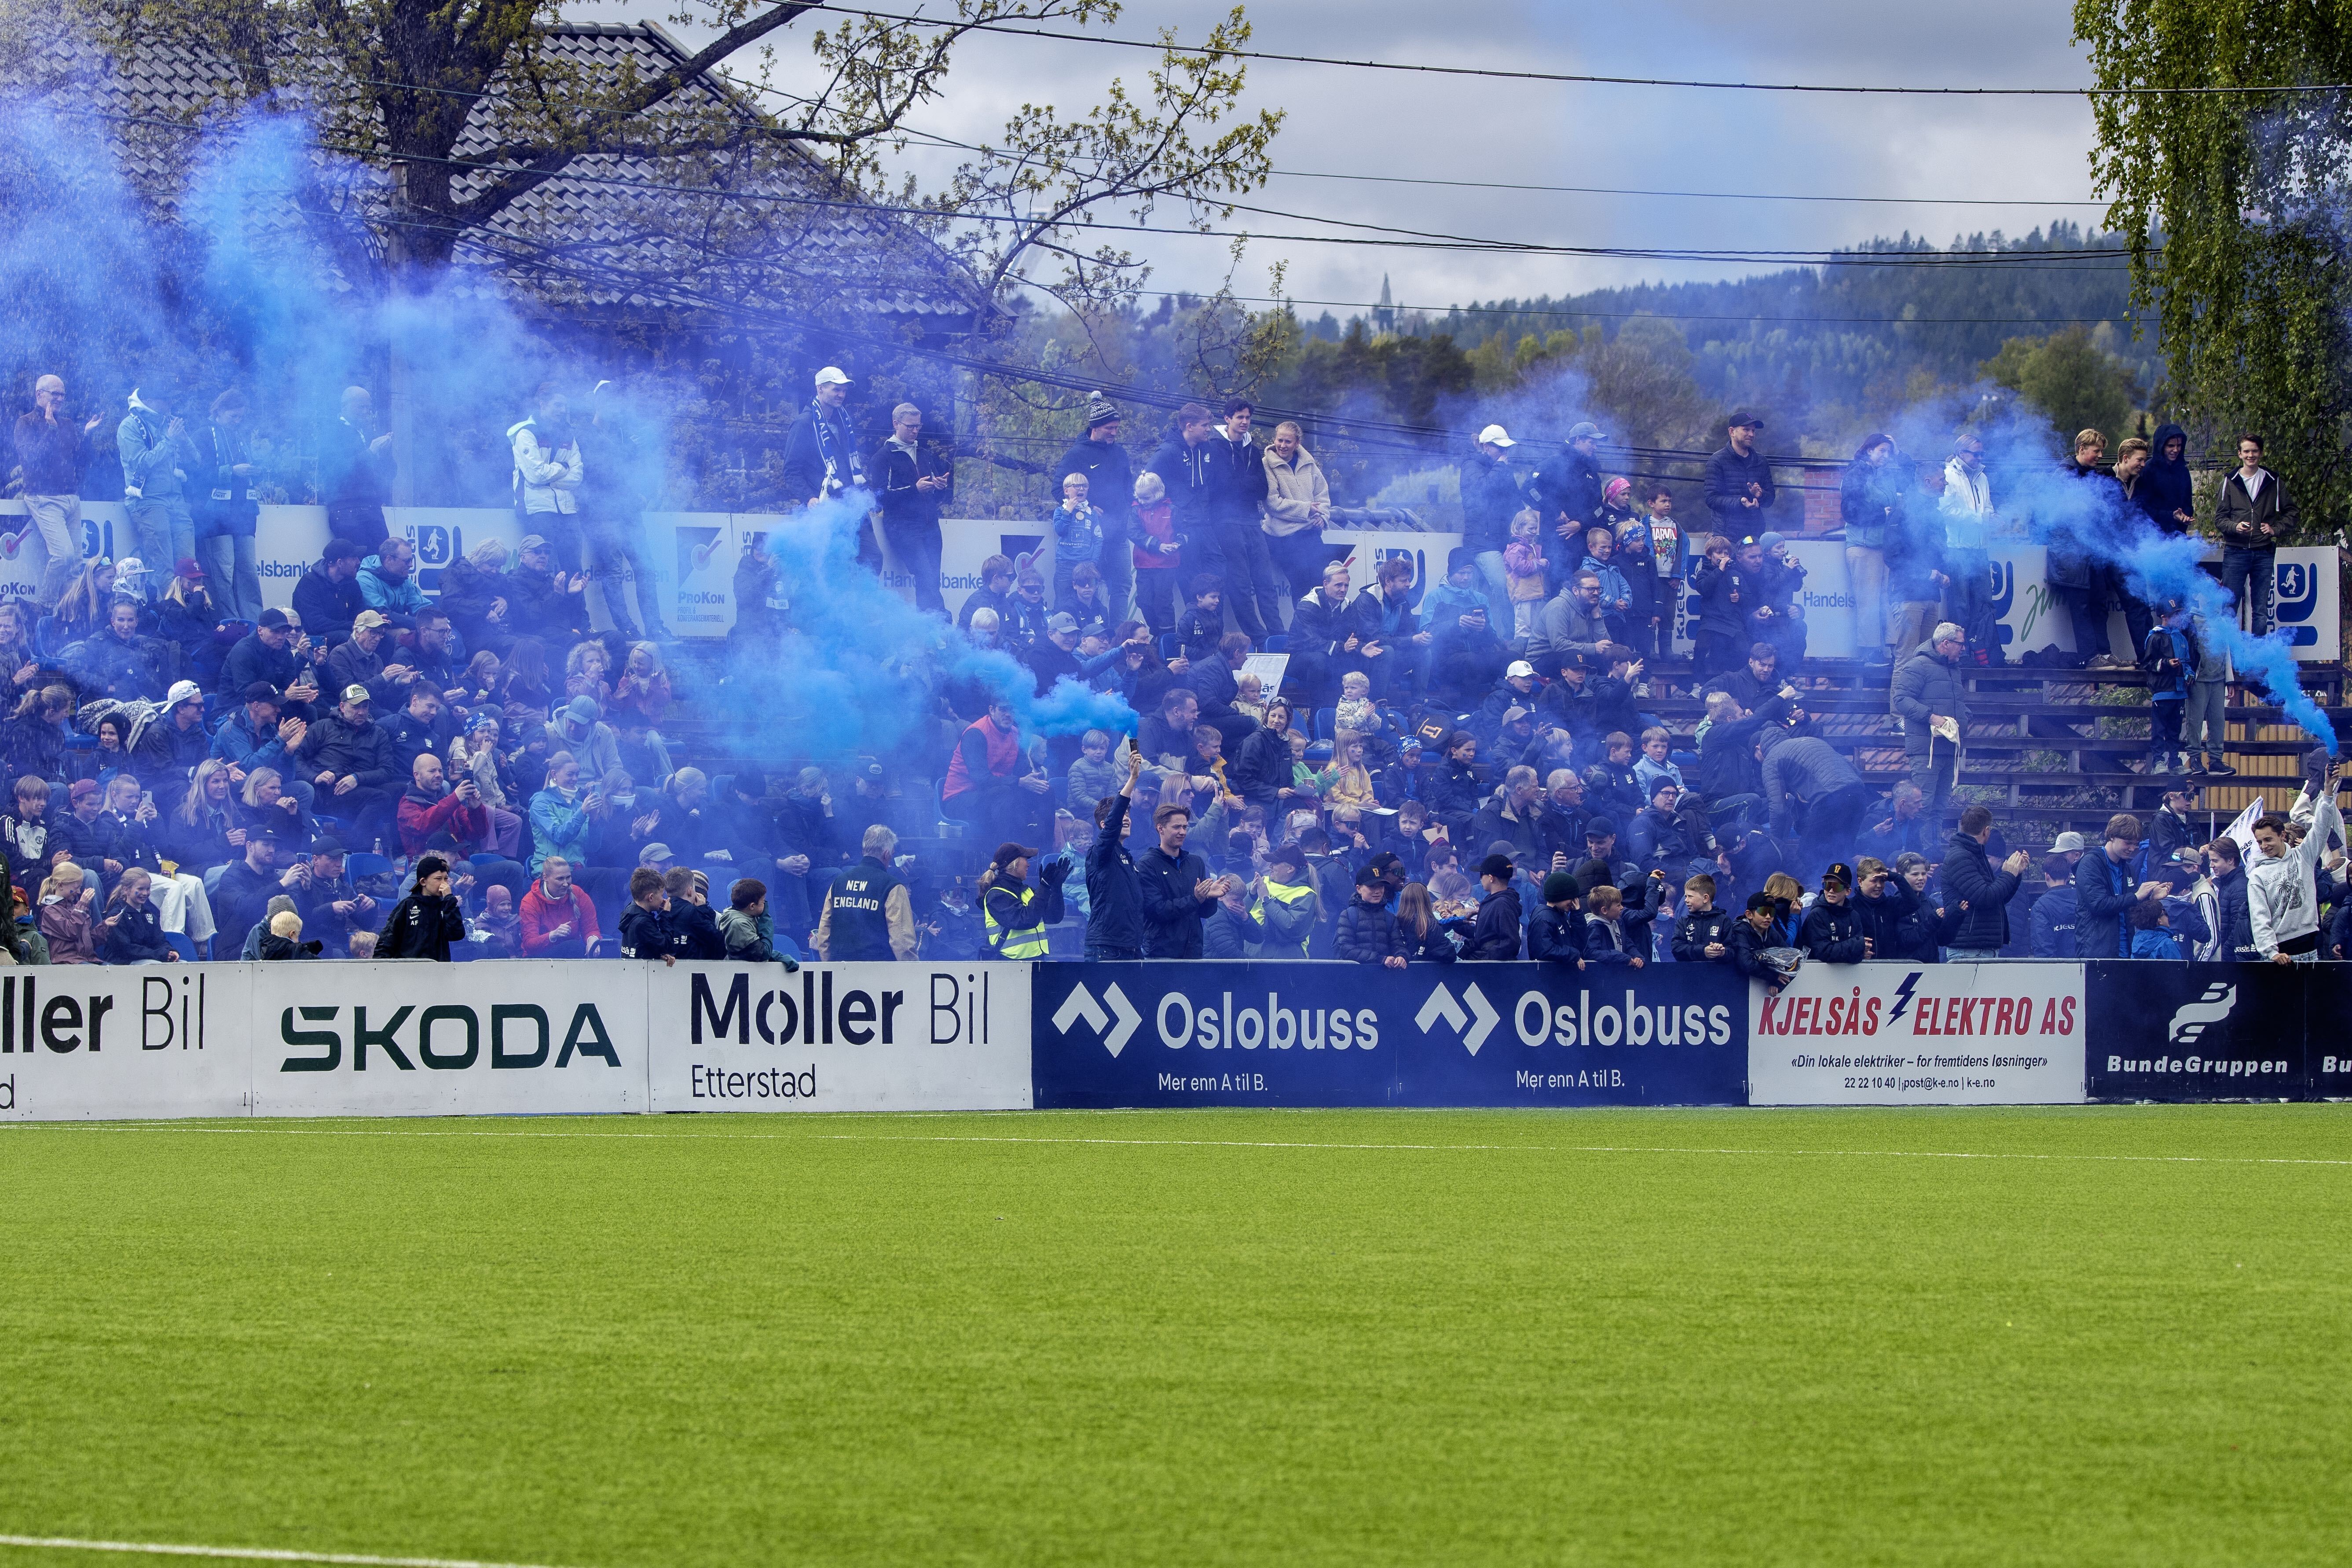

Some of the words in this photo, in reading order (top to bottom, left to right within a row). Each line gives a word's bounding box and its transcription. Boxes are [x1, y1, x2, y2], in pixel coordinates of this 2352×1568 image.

[846, 880, 868, 892] NEW
[834, 896, 879, 911] ENGLAND
[142, 973, 205, 1051] Bil
[931, 971, 988, 1044] Bil
[1515, 989, 1731, 1047] Oslobuss
[1759, 986, 1881, 1036] KJELSÅS
[1913, 997, 2032, 1036] ELEKTRO
[2041, 996, 2076, 1035] AS
[1157, 992, 1378, 1050] Oslobuss
[1791, 1055, 1815, 1067] «Din
[1818, 1055, 1851, 1068] lokale
[1854, 1055, 1905, 1068] elektriker
[1917, 1055, 1932, 1067] for
[1934, 1055, 1989, 1067] fremtidens
[1992, 1054, 2048, 1070] løsninger»
[2107, 1055, 2287, 1077] BundeGruppen
[692, 1063, 816, 1098] Etterstad
[1159, 1073, 1187, 1091] Mer
[1191, 1077, 1216, 1091] enn
[1221, 1073, 1232, 1091] A
[1235, 1073, 1249, 1091] til
[1254, 1073, 1268, 1091] B.
[1517, 1070, 1544, 1088] Mer
[1548, 1074, 1574, 1088] enn
[1578, 1070, 1589, 1087] A
[1592, 1069, 1607, 1087] til
[1612, 1070, 1625, 1087] B.
[1844, 1077, 1855, 1088] 22
[1858, 1077, 1869, 1088] 22
[1872, 1077, 1882, 1088] 10
[1884, 1077, 1895, 1088] 40
[1967, 1077, 1995, 1088] k-e.no
